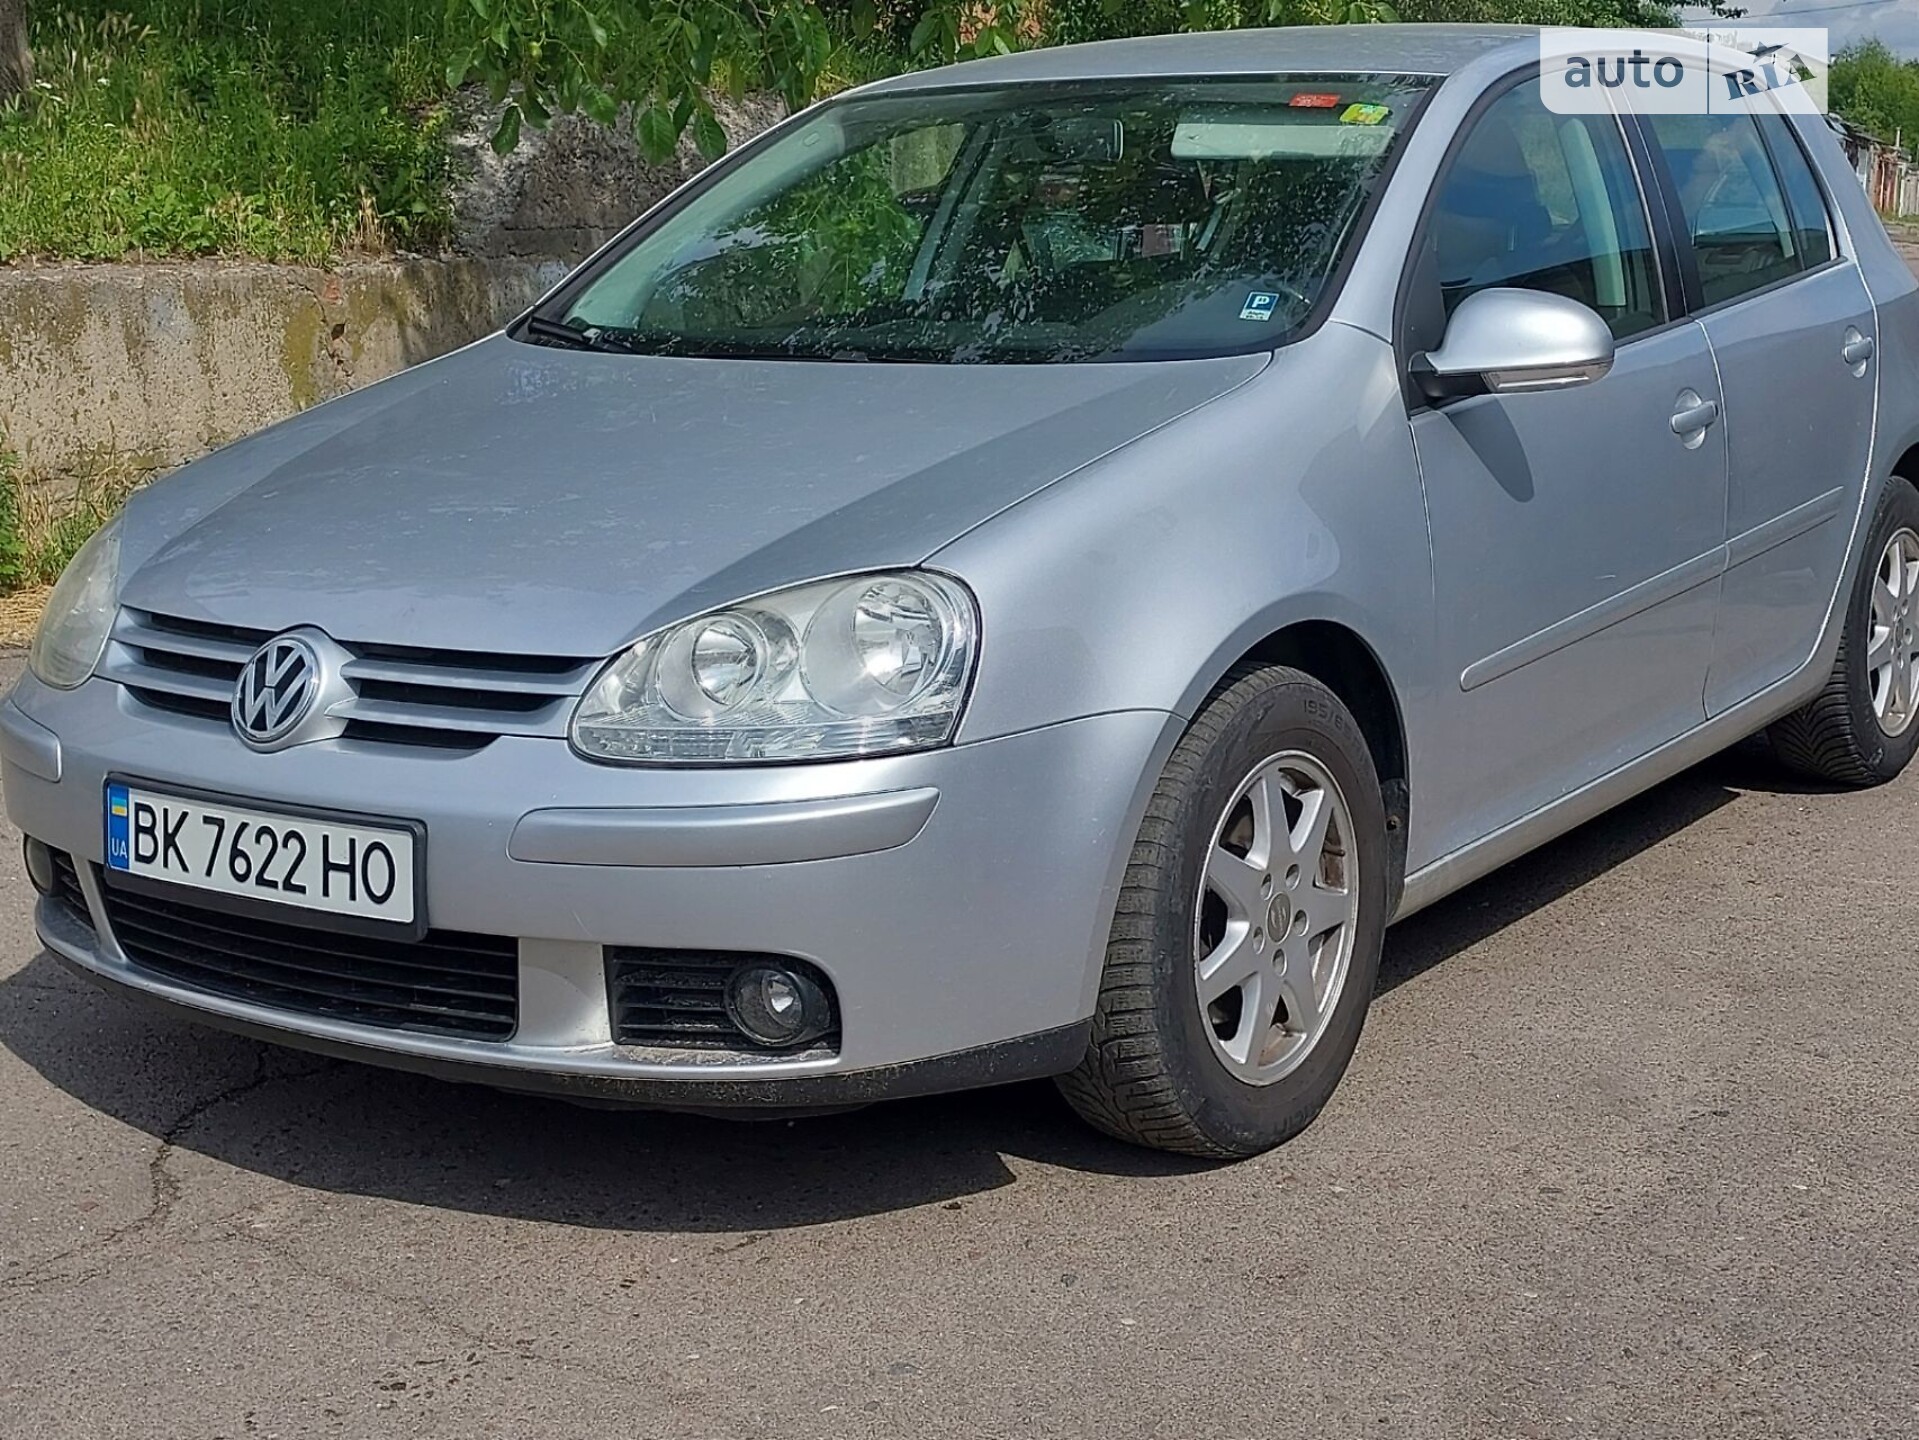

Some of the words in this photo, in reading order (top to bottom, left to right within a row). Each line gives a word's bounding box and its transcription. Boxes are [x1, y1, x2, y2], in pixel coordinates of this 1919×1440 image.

[1252, 295, 1270, 308] P
[111, 839, 128, 859] UA
[134, 801, 190, 873] BK
[202, 816, 307, 895] 7622
[322, 834, 396, 905] HO
